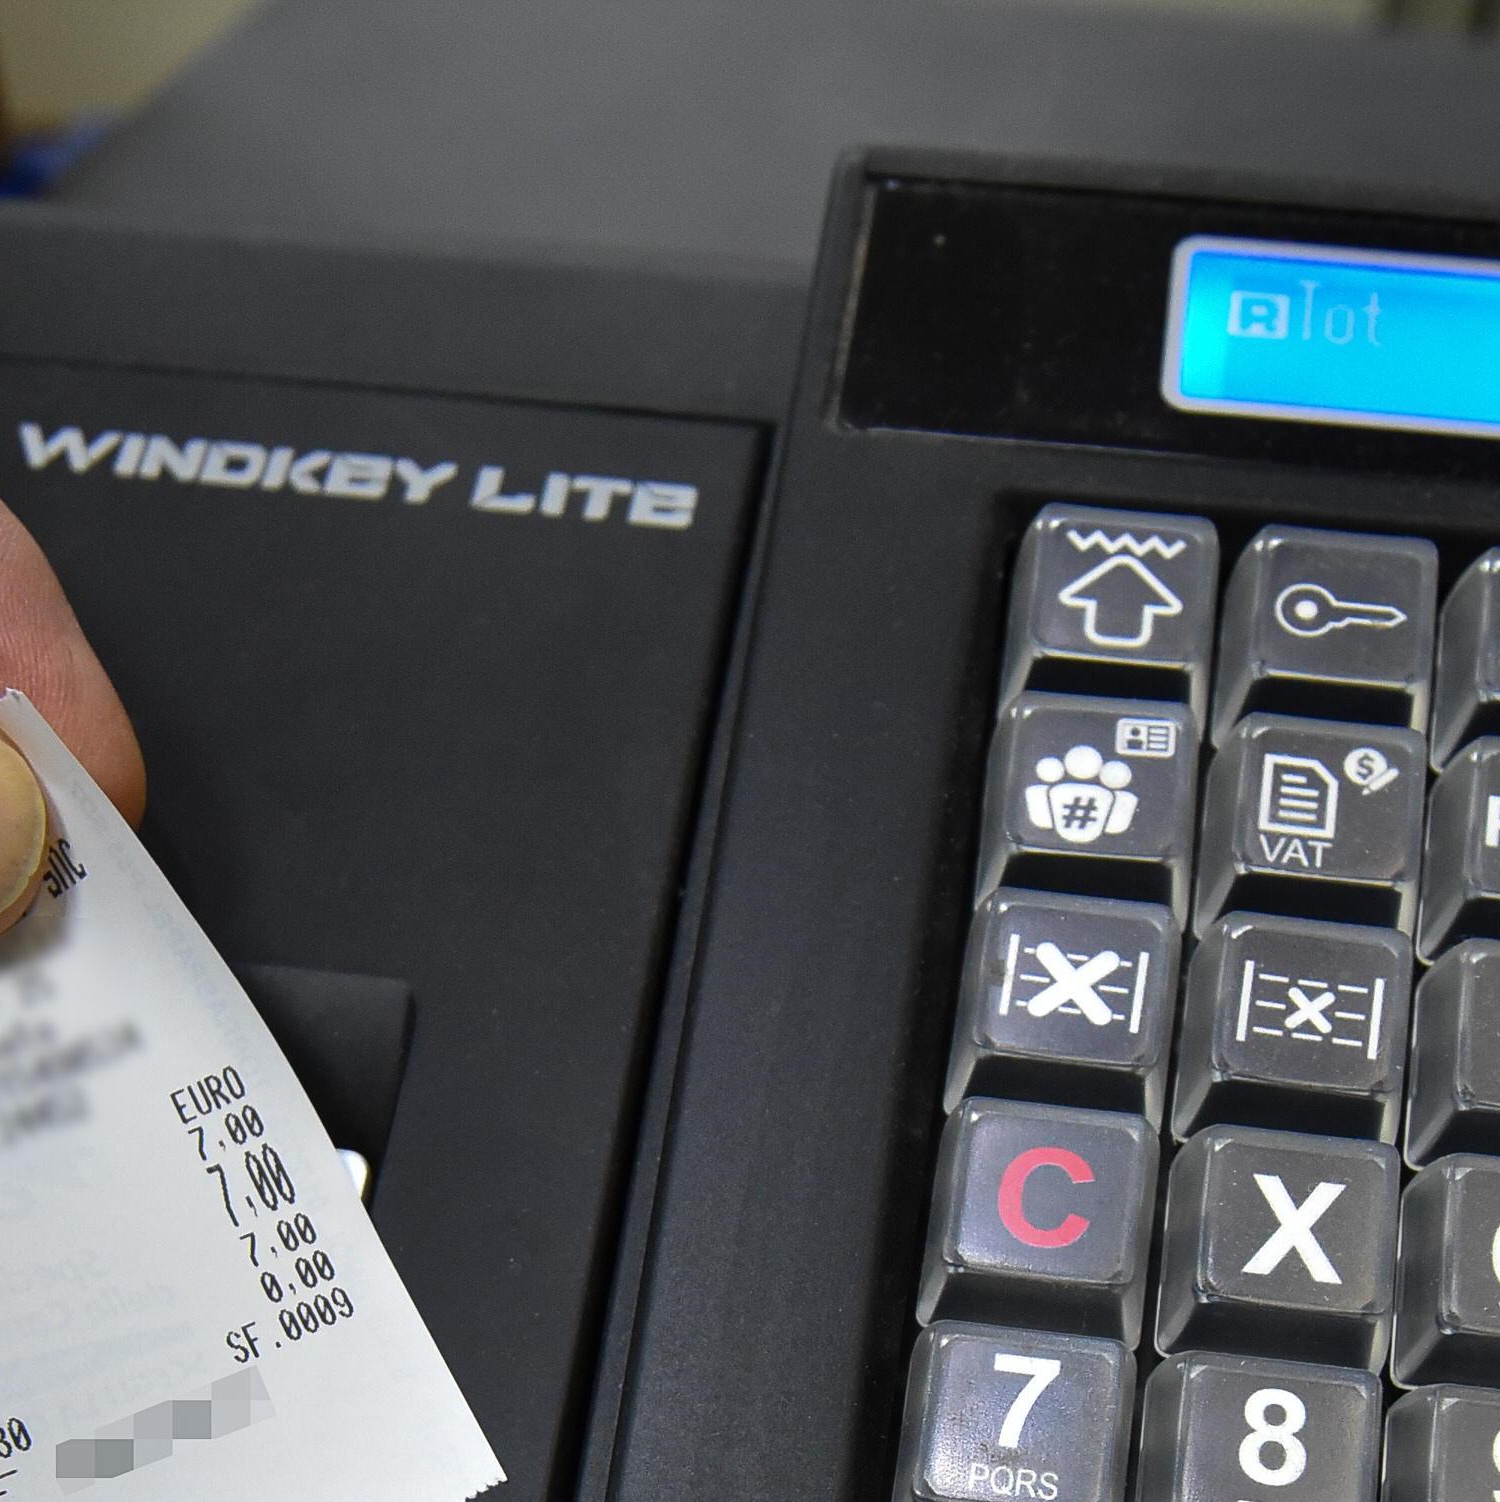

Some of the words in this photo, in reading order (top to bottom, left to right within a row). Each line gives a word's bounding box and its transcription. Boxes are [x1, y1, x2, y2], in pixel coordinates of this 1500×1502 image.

[20, 423, 457, 504] WINDKEY
[471, 465, 698, 529] LITE
[1260, 833, 1332, 869] VAT
[170, 1065, 246, 1124] EURO
[998, 1146, 1096, 1249] C
[1241, 1172, 1346, 1285] X
[993, 1353, 1062, 1450] 7
[1237, 1387, 1309, 1487] 8
[967, 1463, 1060, 1502] PQRS
